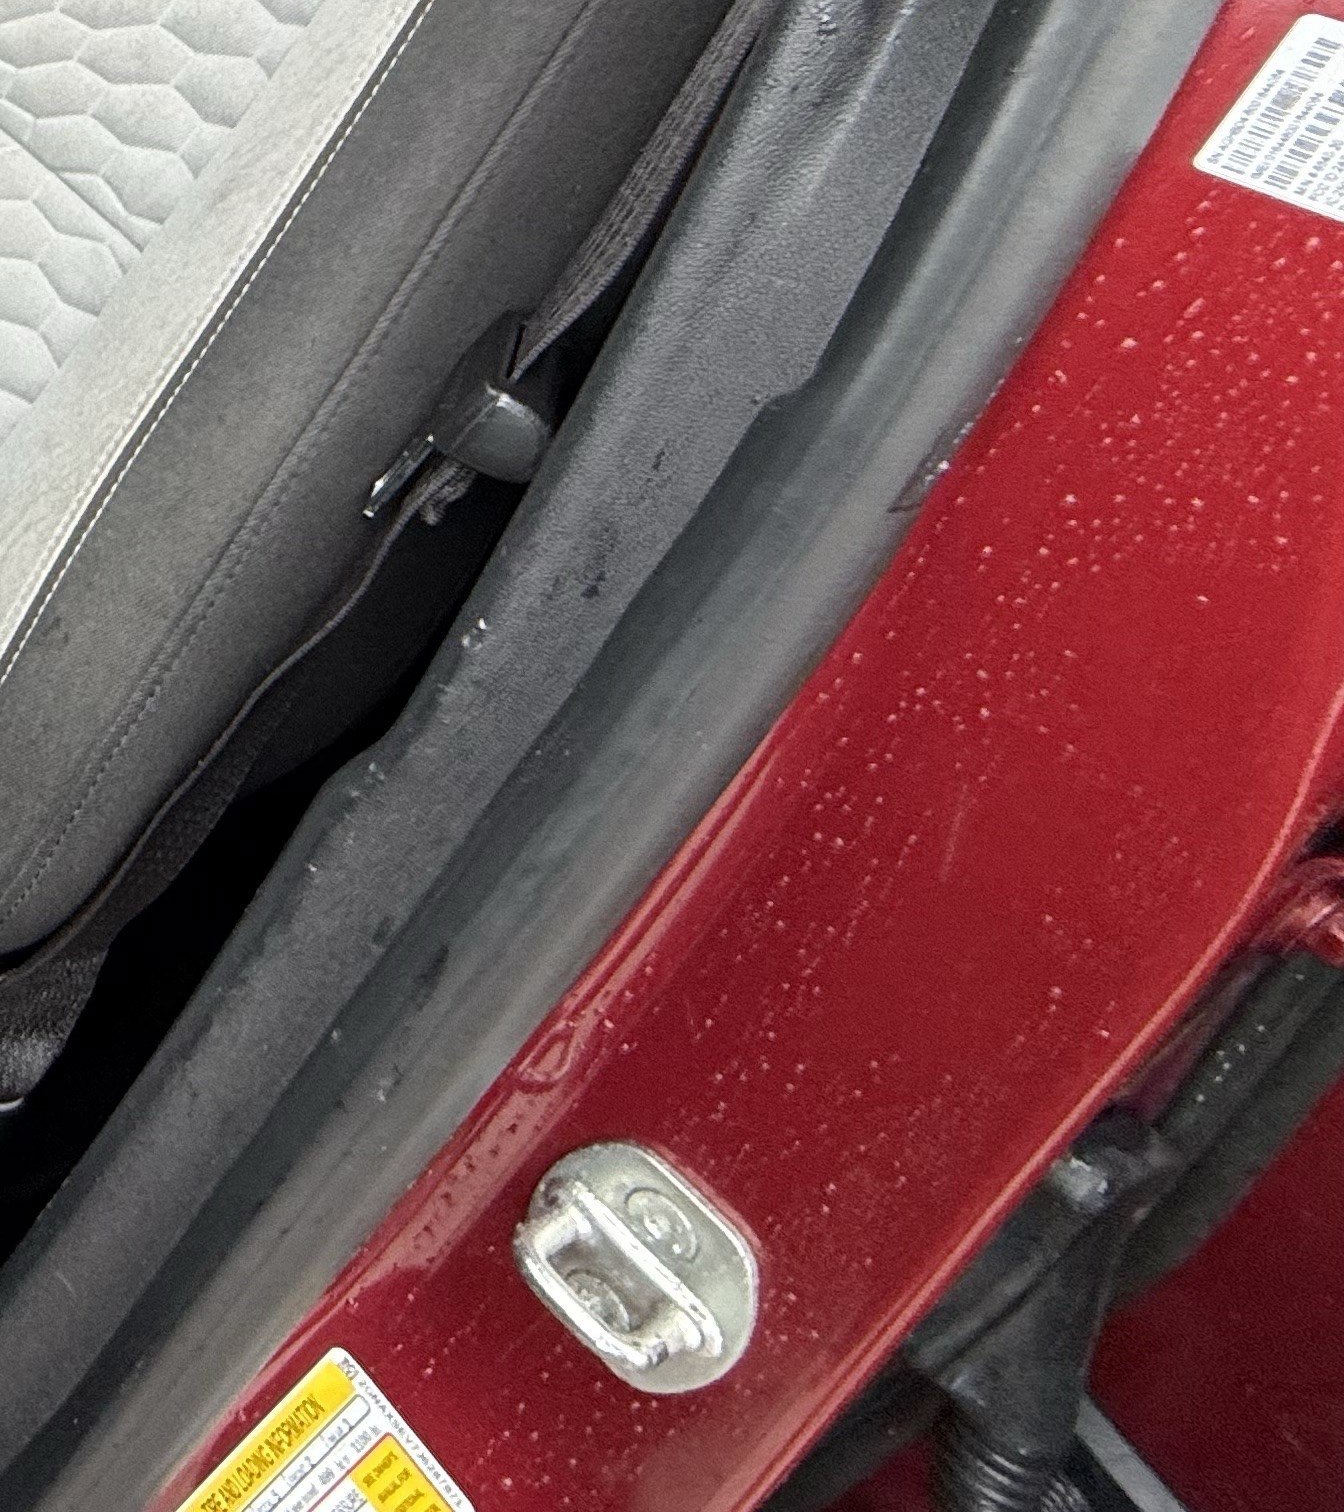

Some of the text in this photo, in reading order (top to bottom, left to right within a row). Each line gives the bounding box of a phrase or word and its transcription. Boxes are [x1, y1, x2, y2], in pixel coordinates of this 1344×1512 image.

[216, 1477, 243, 1507] AND
[230, 1444, 276, 1492] LOADING
[263, 1393, 326, 1459] INFORMATION
